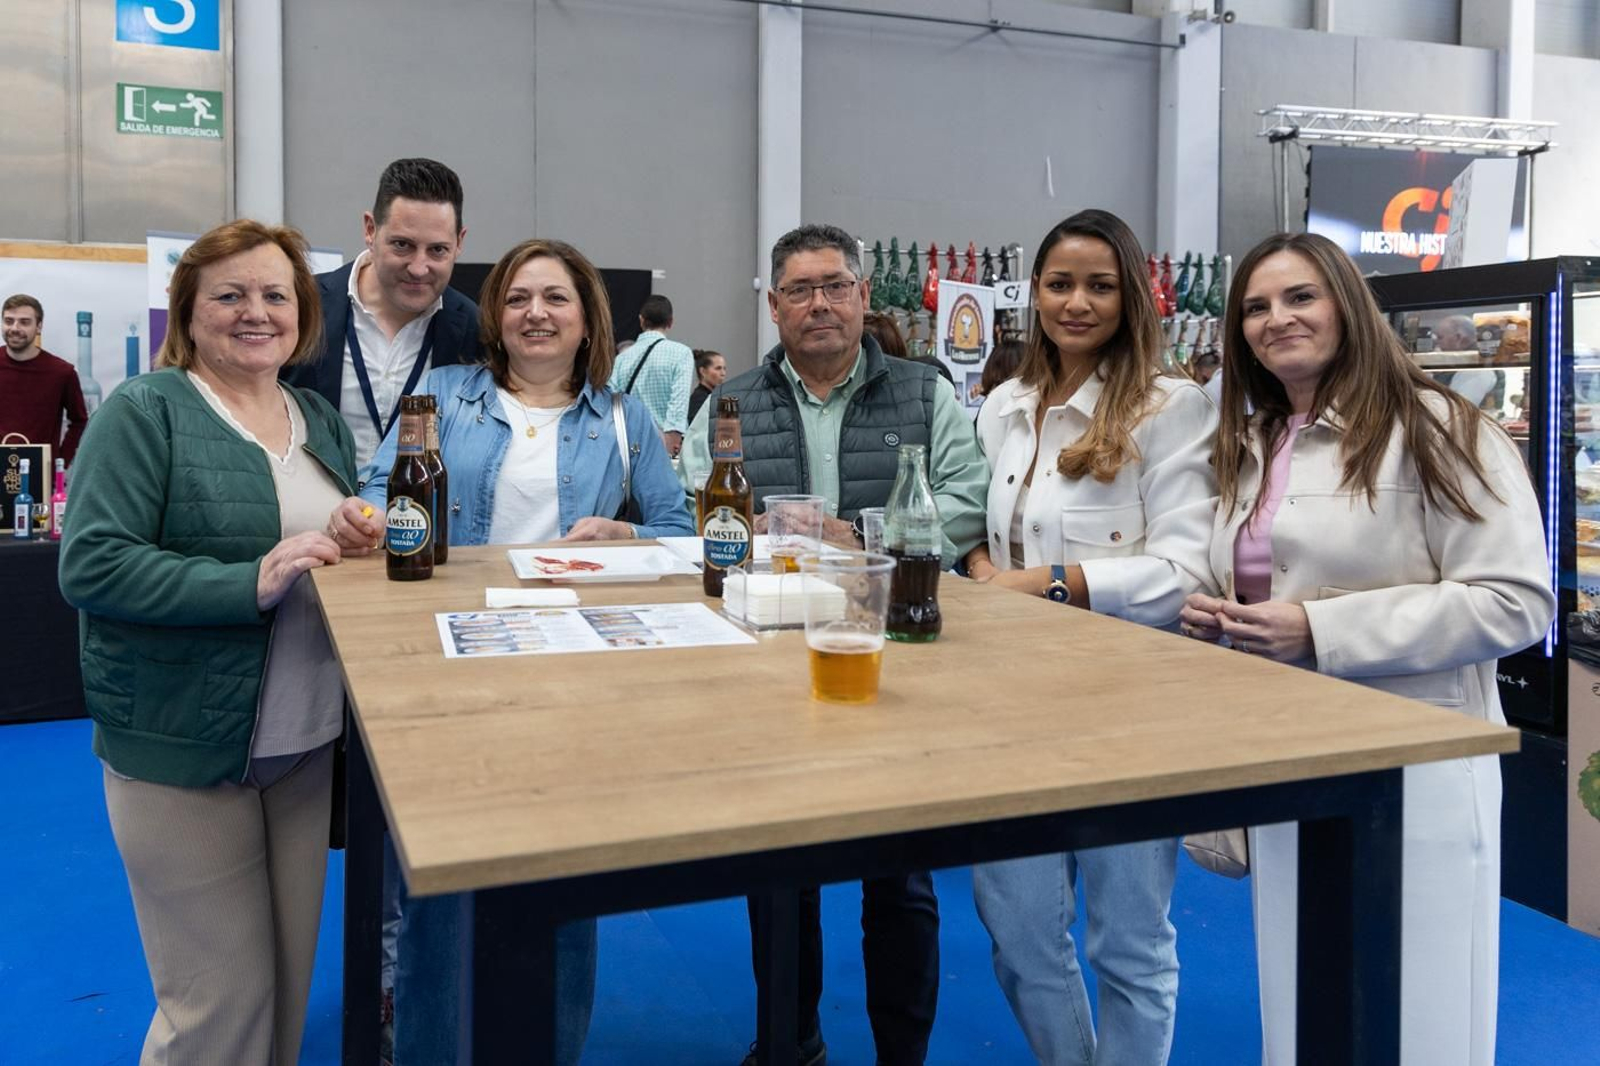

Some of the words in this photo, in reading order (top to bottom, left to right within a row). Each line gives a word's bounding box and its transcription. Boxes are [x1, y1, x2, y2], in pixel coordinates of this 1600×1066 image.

[120, 122, 151, 133] SALIDA
[152, 124, 165, 134] DE
[166, 126, 220, 138] EMERGENCIA
[1360, 231, 1416, 255] NUESTRA
[388, 518, 422, 528] AMSTEL
[706, 529, 746, 540] AMSTEL
[390, 538, 415, 546] TOSTADA
[710, 552, 738, 560] TOSTADA
